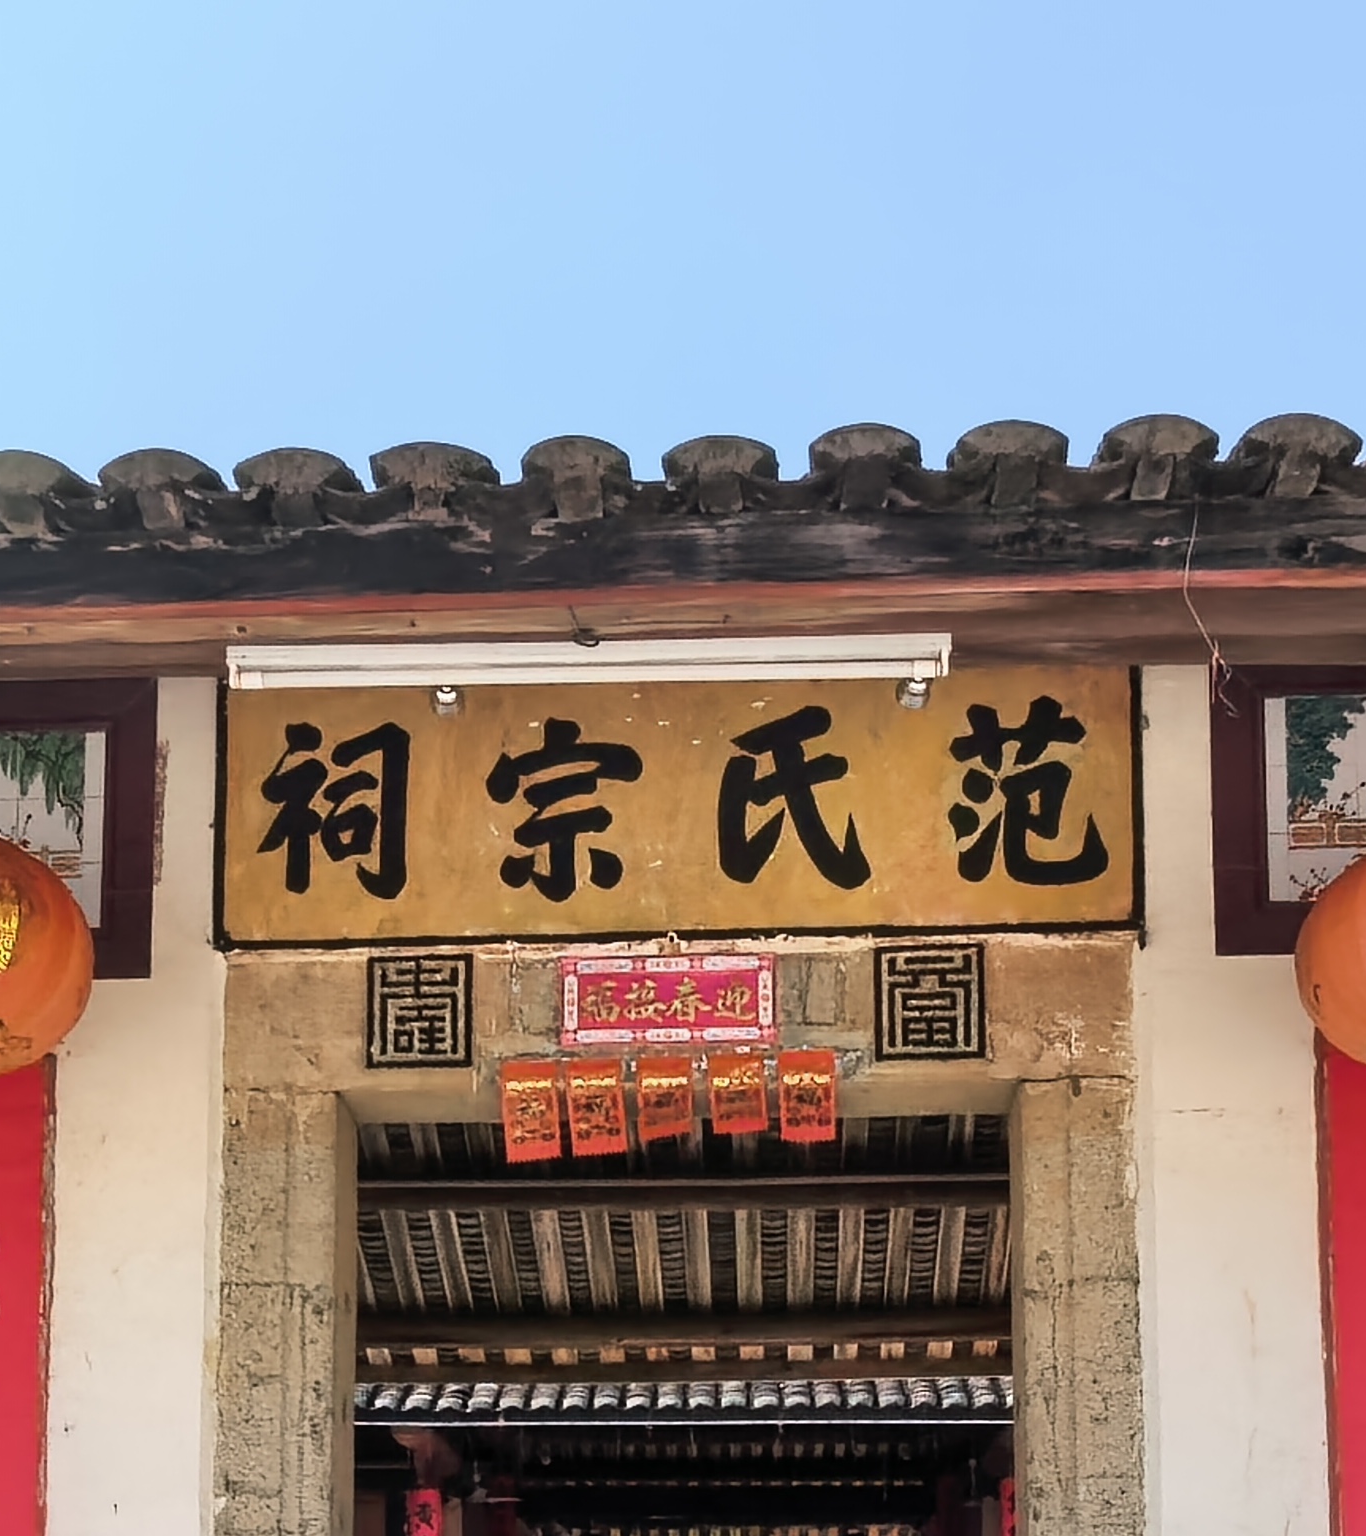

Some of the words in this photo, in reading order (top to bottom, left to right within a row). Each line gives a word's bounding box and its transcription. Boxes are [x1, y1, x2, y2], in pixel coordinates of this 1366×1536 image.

[257, 696, 1110, 902] 范氏宗祠
[581, 976, 757, 1024] 迎春接福
